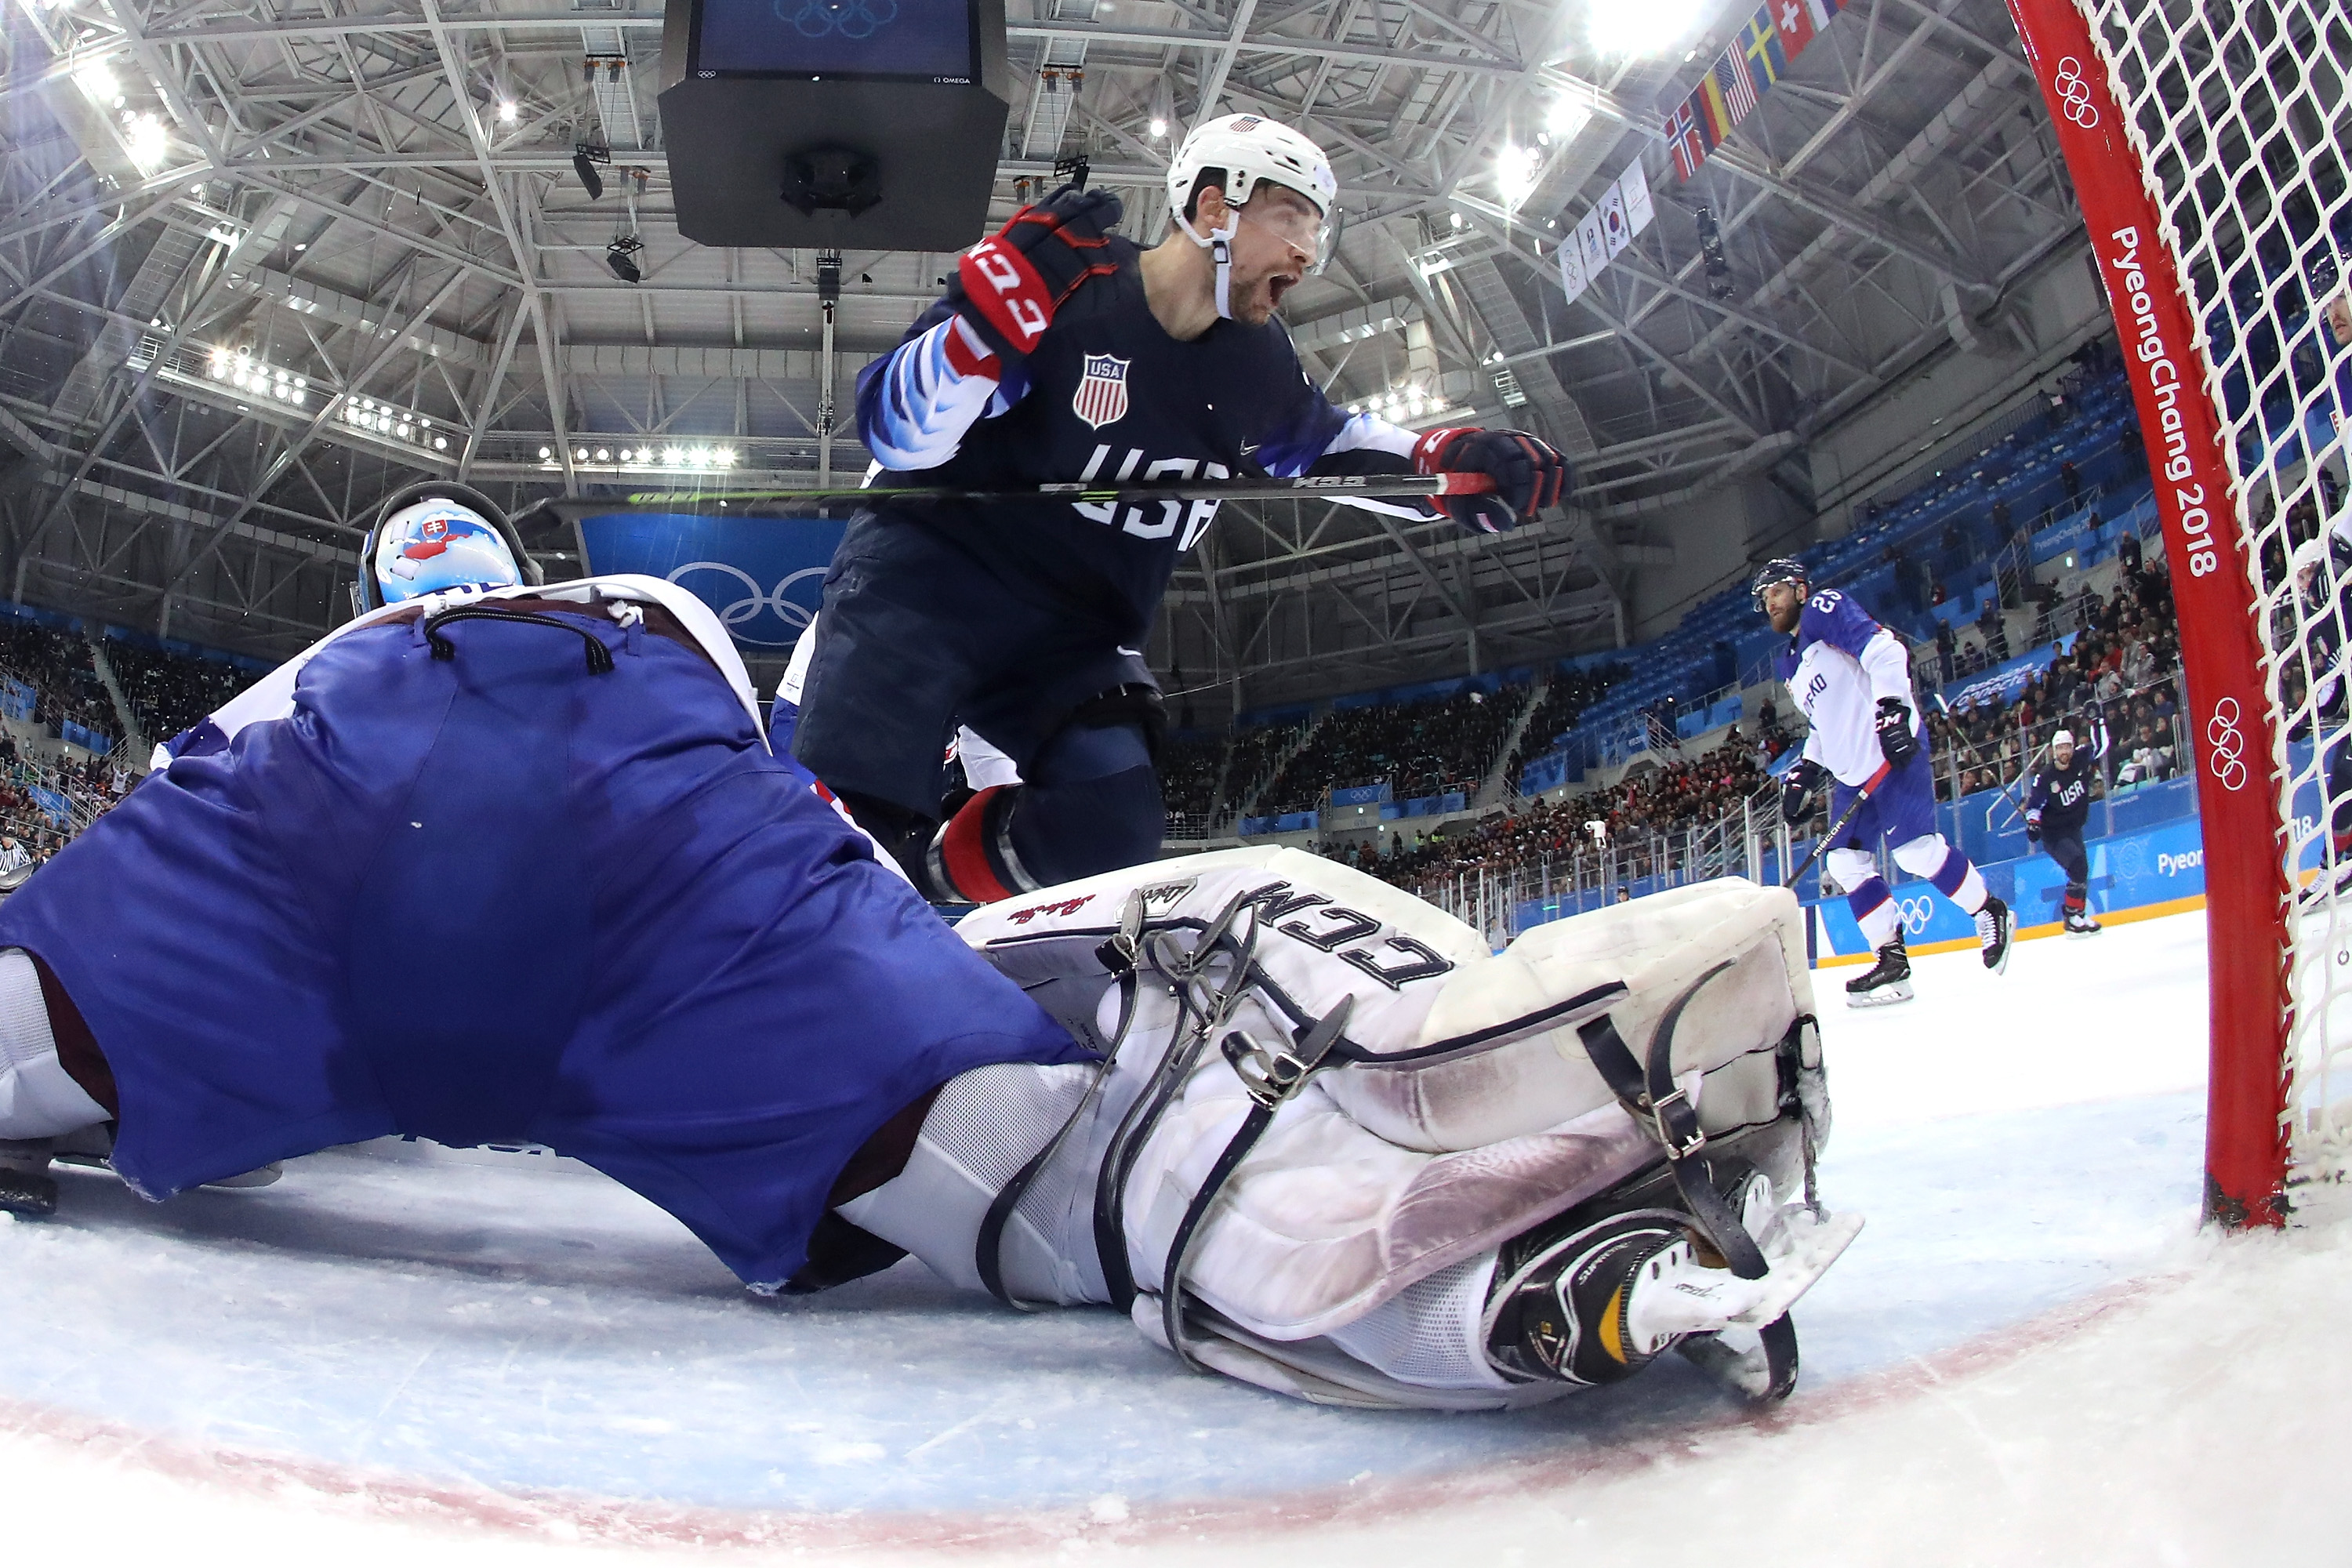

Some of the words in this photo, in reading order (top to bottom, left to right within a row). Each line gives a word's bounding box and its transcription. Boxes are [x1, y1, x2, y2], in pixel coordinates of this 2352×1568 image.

[1091, 361, 1120, 378] USA
[2111, 226, 2193, 482] PyeongChang
[2176, 483, 2217, 578] 2018
[1071, 444, 1229, 552] USA
[1291, 476, 1367, 488] CCM
[2060, 780, 2085, 807] USA
[1812, 820, 1845, 857] RIBCOR
[1234, 880, 1454, 991] CCM
